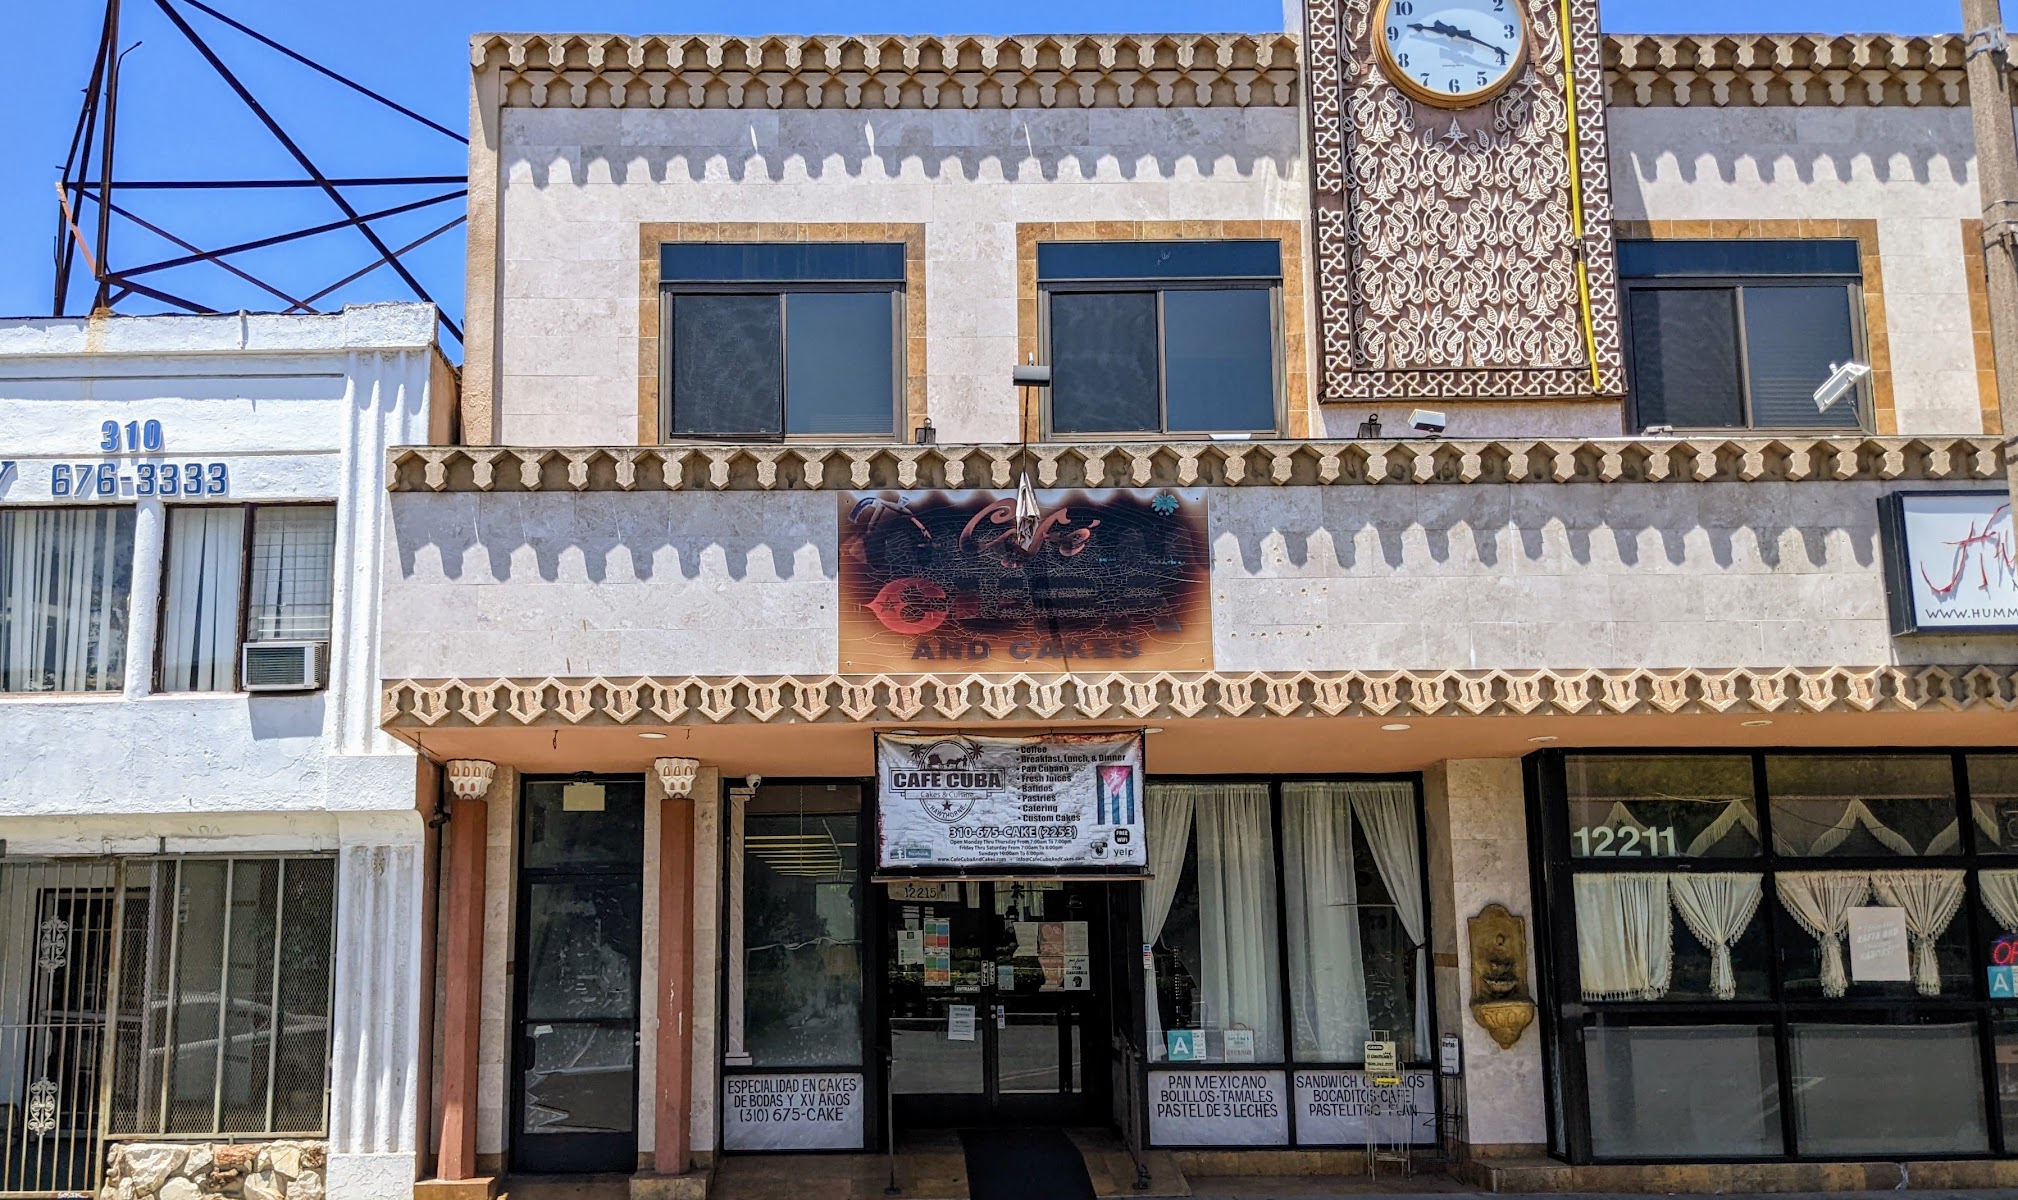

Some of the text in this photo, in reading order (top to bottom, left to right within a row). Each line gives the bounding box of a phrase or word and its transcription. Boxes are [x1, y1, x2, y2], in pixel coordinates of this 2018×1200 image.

[1395, 1, 1413, 16] 10
[1493, 0, 1504, 12] 2
[1387, 26, 1399, 41] 9
[1504, 24, 1515, 40] 3
[1398, 53, 1409, 68] 8
[1495, 51, 1507, 66] 4
[1420, 73, 1430, 87] 7
[1477, 71, 1487, 86] 5
[1448, 79, 1460, 94] 6
[101, 420, 162, 452] 310
[51, 463, 228, 497] 676-3333
[911, 640, 1141, 660] AND CAKES
[1021, 755, 1062, 763] Breakfast,
[1064, 754, 1090, 763] Lunch,
[1099, 754, 1126, 762] Dinner
[894, 773, 1001, 788] CAFE CUBA
[1046, 774, 1072, 782] Juices
[921, 790, 940, 798] Cakes
[930, 804, 966, 818] HAWTHORNE
[1022, 804, 1058, 813] Catering
[1023, 814, 1080, 822] Custom Cakes
[949, 826, 1078, 839] 310-675-CAKE (2253)
[1573, 826, 1676, 857] 12211
[1114, 848, 1134, 857] yelp
[905, 887, 937, 899] 12215
[1993, 973, 2009, 991] A
[1173, 1037, 1189, 1054] A
[728, 1078, 857, 1094] ESPECIALIDAD EN CAKES
[1168, 1075, 1267, 1089] PAN MEXICANO
[1296, 1075, 1357, 1088] SANDWICH
[734, 1092, 850, 1108] DE BODAS Y XV AÑOS
[740, 1107, 844, 1123] (310) 675-CAKE
[1157, 1104, 1278, 1118] PASTEL DE 3 LECHES
